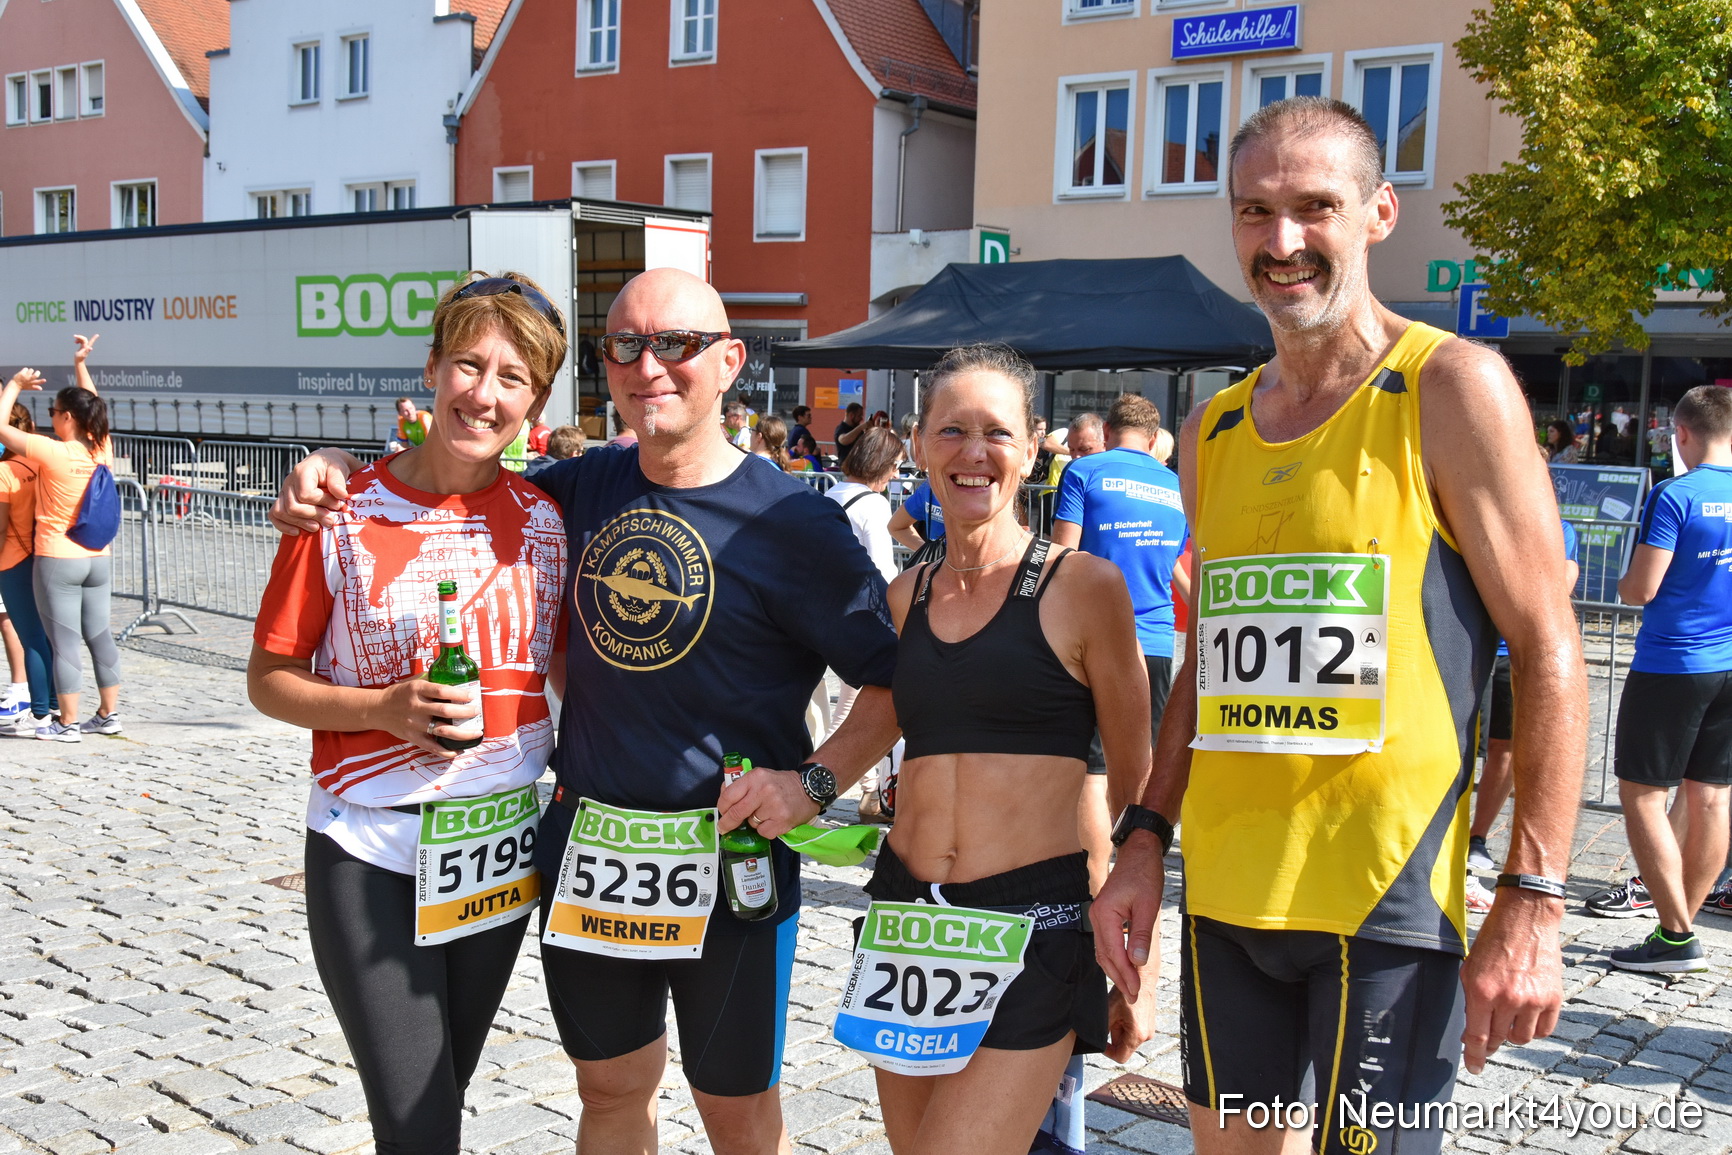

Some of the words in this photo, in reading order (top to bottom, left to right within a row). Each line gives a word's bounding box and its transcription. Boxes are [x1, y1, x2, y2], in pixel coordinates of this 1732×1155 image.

[984, 239, 1006, 264] D
[16, 301, 67, 323] OFFICE
[74, 298, 155, 322] INDUSTRY
[163, 295, 238, 320] LOUNGE
[67, 369, 182, 388] ww.bockonline.de
[298, 372, 354, 394] inspired
[358, 373, 375, 396] by
[380, 375, 424, 392] smart
[1599, 473, 1640, 484] BOCK
[1098, 523, 1113, 531] Mit
[1114, 520, 1153, 530] Sicherheit
[1143, 529, 1164, 537] einen
[586, 518, 704, 587] KAMPFSCHWIMMER
[1135, 538, 1160, 547] Schritt
[1020, 578, 1035, 597] PUSH
[1210, 566, 1364, 608] BOCK
[592, 621, 673, 661] KOMPANIE
[1365, 632, 1376, 644] A
[1213, 625, 1355, 685] 1012
[1220, 703, 1339, 730] THOMAS
[433, 787, 538, 837] BOCK
[580, 810, 703, 849] BOCK
[437, 826, 537, 894] 5199
[703, 866, 711, 875] S
[572, 853, 698, 907] 5236
[742, 880, 767, 891] Dunkel
[457, 886, 521, 921] JUTTA
[581, 914, 681, 942] WERNER
[875, 910, 1012, 955] BOCK
[864, 962, 999, 1017] 2023
[875, 1029, 958, 1055] GISELA
